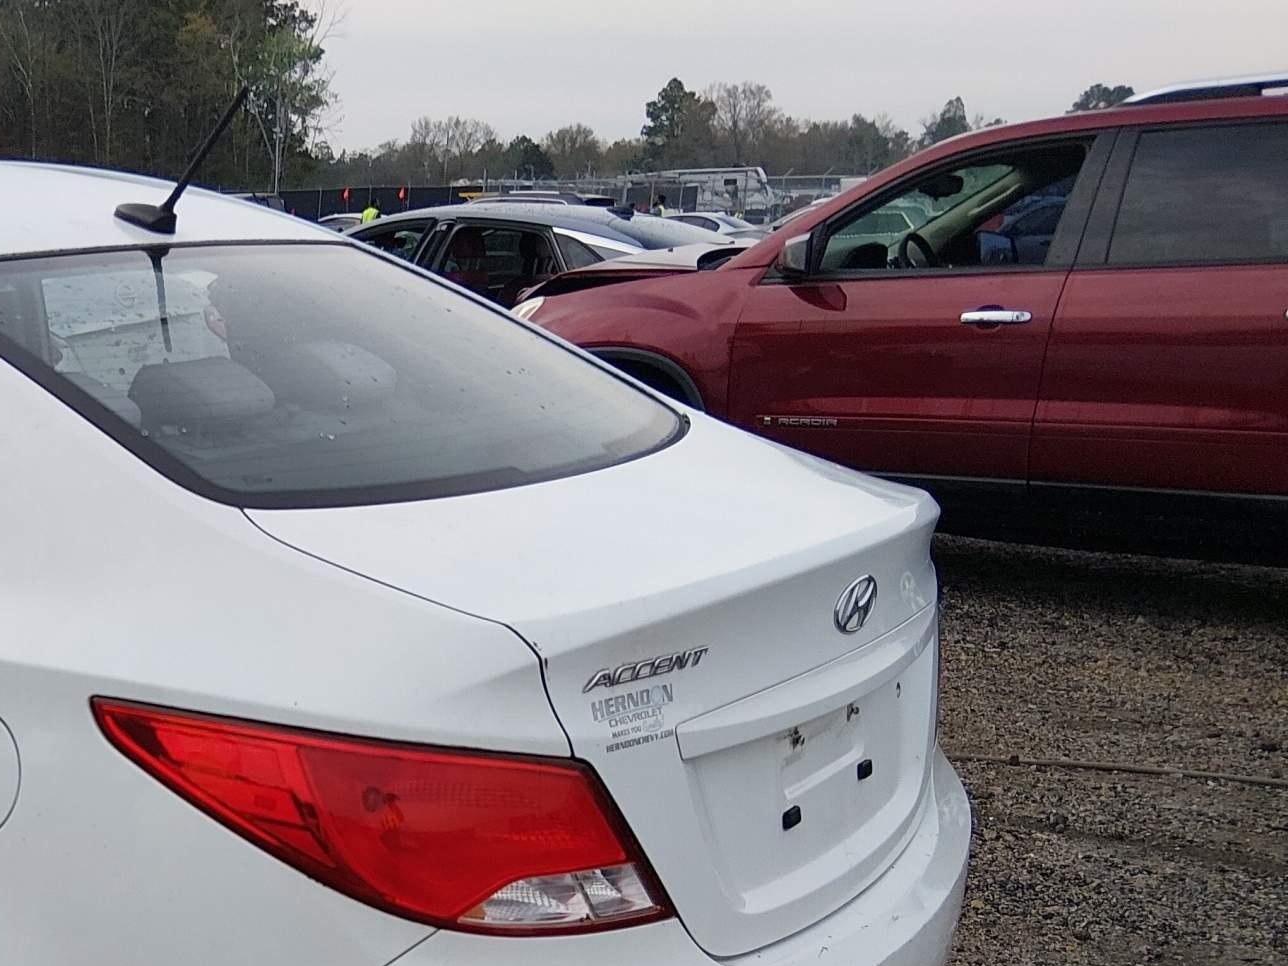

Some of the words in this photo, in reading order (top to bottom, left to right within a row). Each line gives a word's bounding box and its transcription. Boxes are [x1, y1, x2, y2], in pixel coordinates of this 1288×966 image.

[778, 417, 838, 427] ACADIA
[582, 645, 709, 693] ACCENT
[591, 683, 673, 721] HERNDON
[608, 707, 663, 728] CHEVROLET
